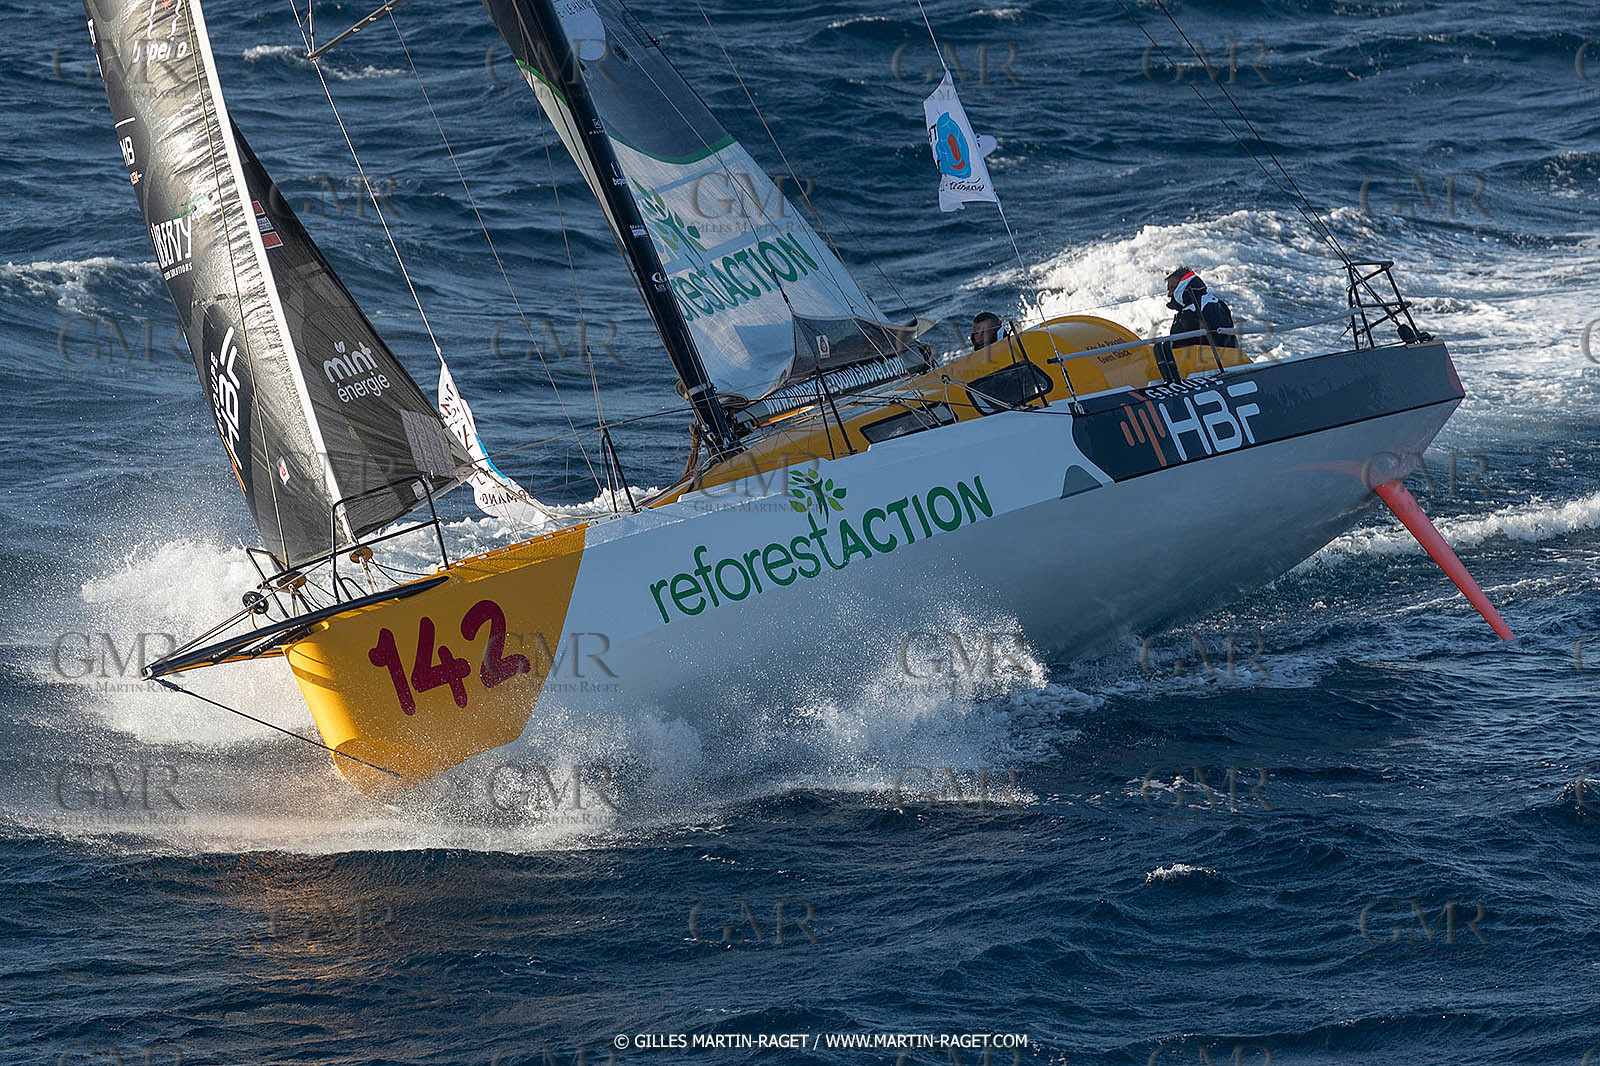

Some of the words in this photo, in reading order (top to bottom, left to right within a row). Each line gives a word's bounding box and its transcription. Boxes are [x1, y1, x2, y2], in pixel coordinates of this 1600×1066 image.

[323, 341, 379, 383] mint
[337, 371, 391, 403] énergie
[1144, 374, 1224, 400] GROUPE
[1158, 380, 1261, 461] HBF
[649, 475, 994, 624] reforestACTION
[368, 600, 531, 716] 142
